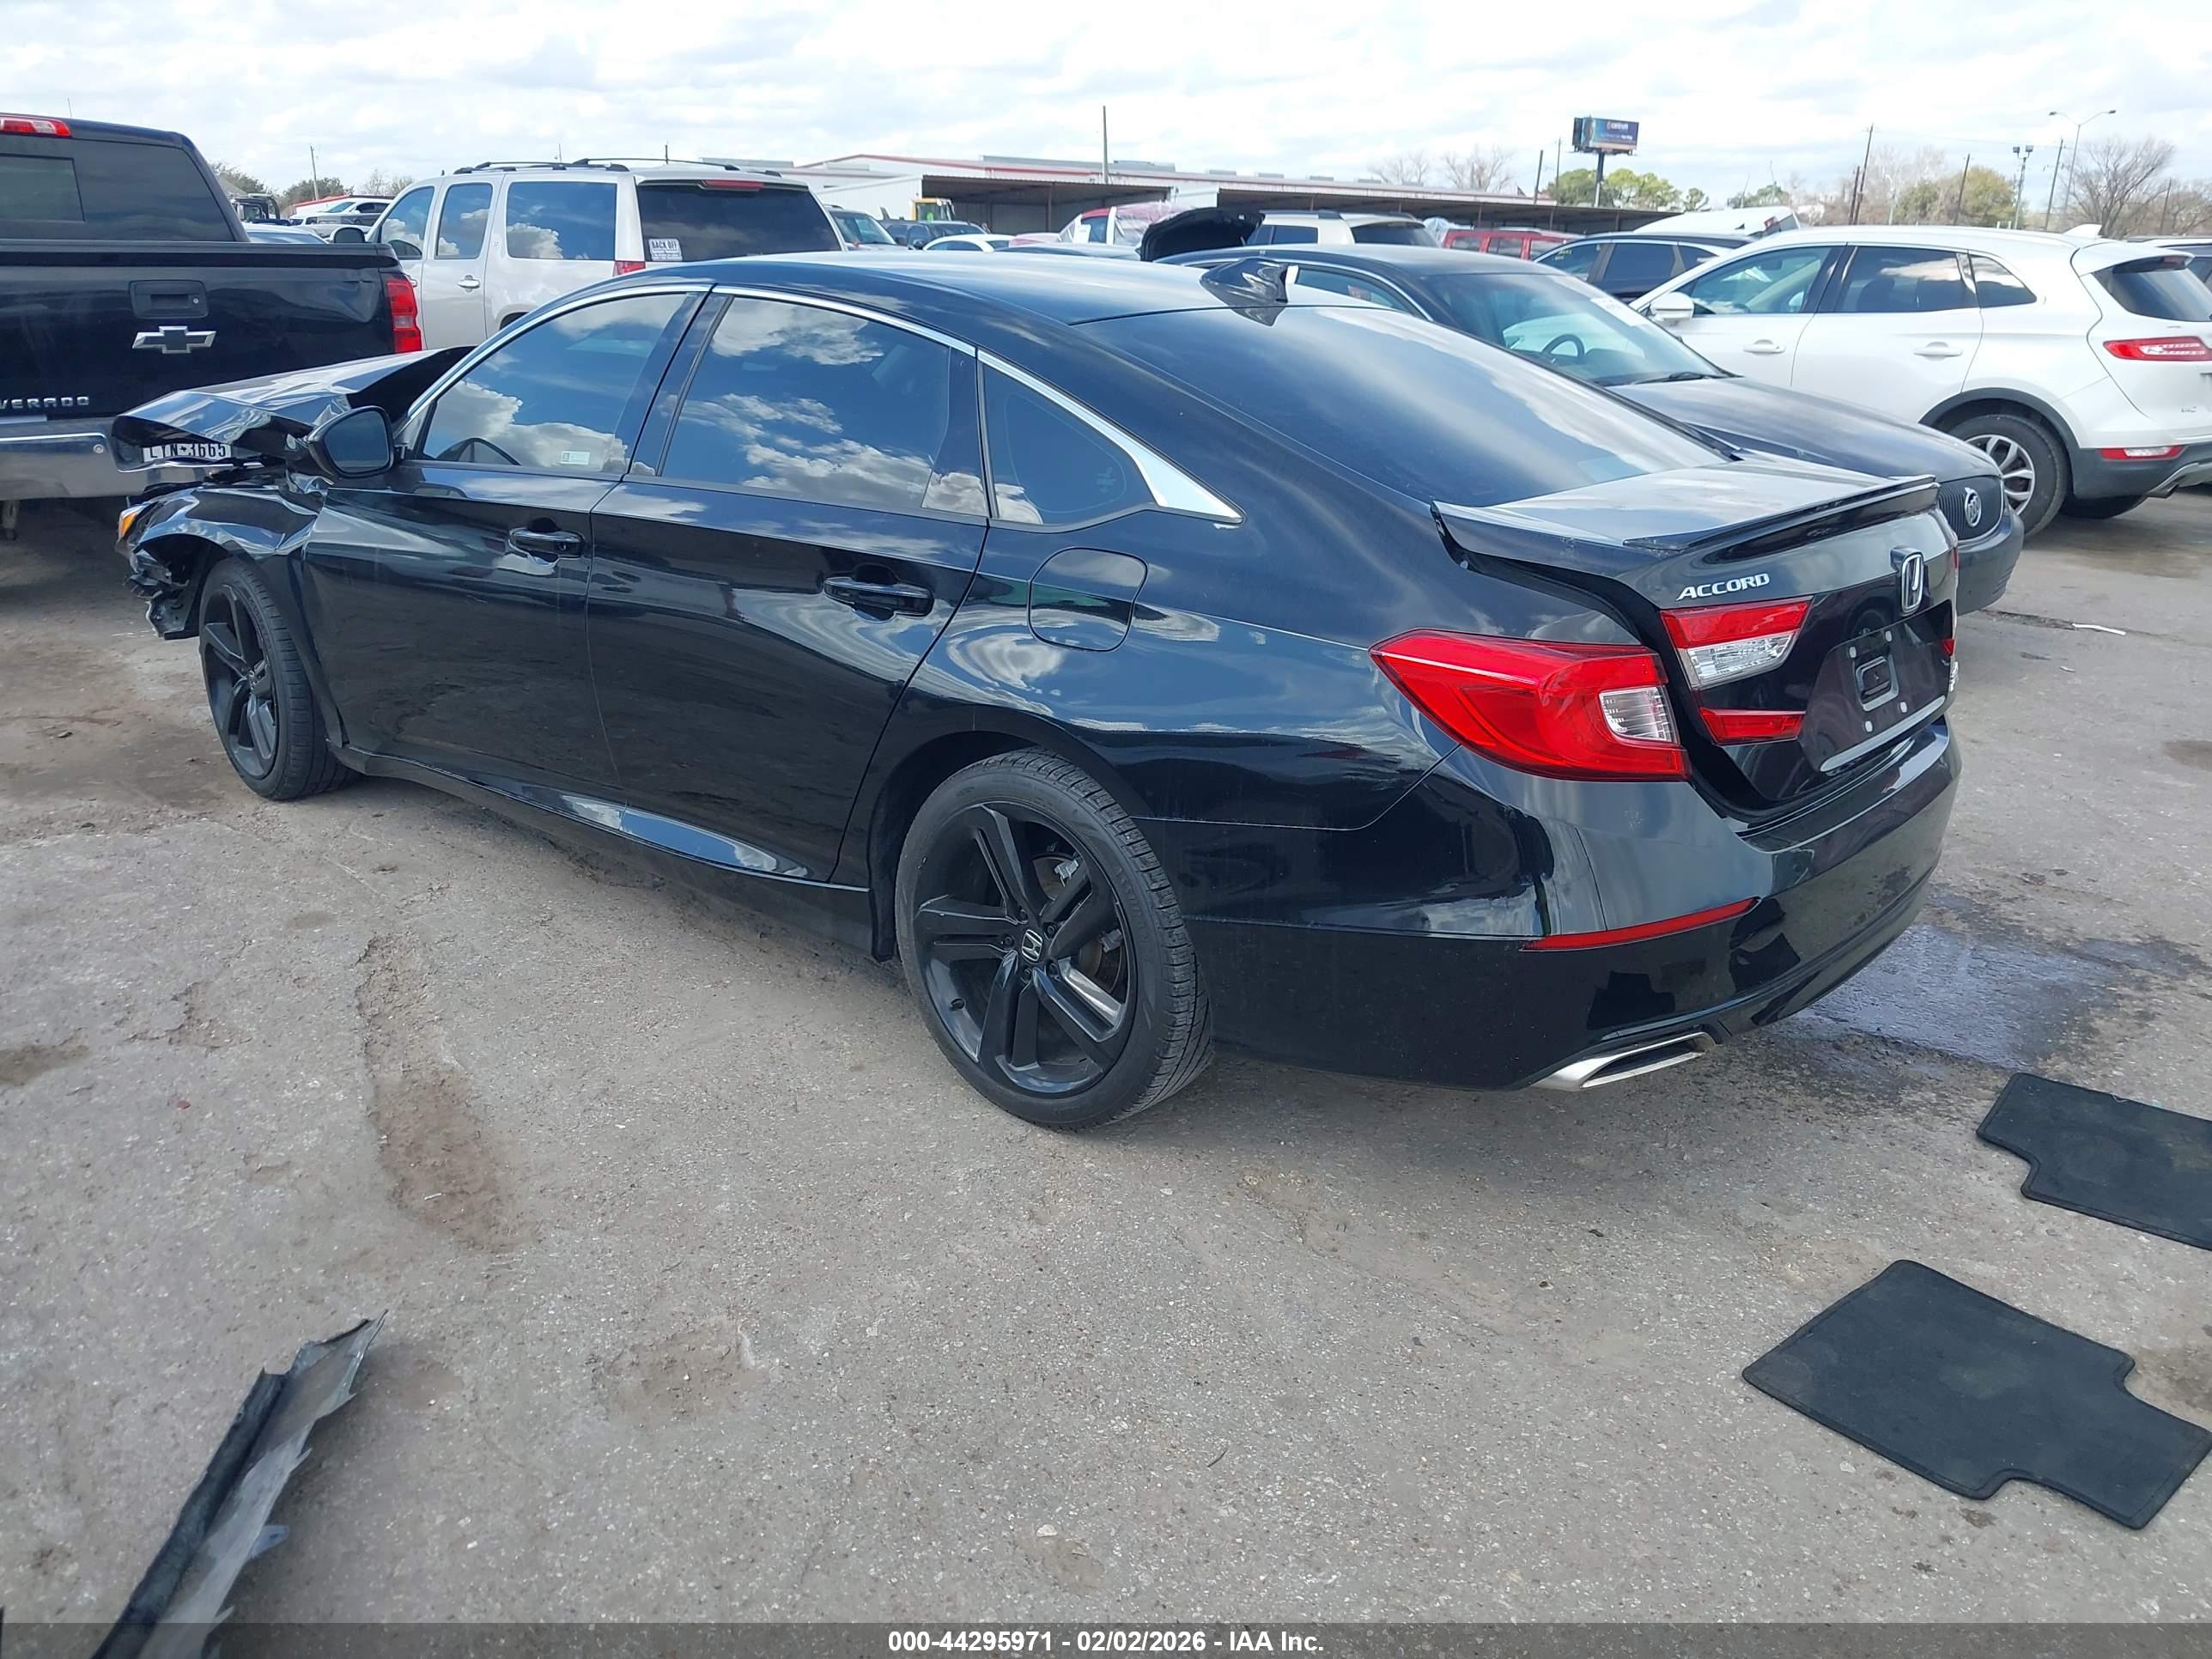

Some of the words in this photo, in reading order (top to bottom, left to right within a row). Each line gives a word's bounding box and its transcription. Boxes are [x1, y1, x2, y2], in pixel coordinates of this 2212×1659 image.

[652, 240, 667, 249] BACK
[667, 240, 678, 249] OFF
[1675, 573, 1771, 602] ACCORD
